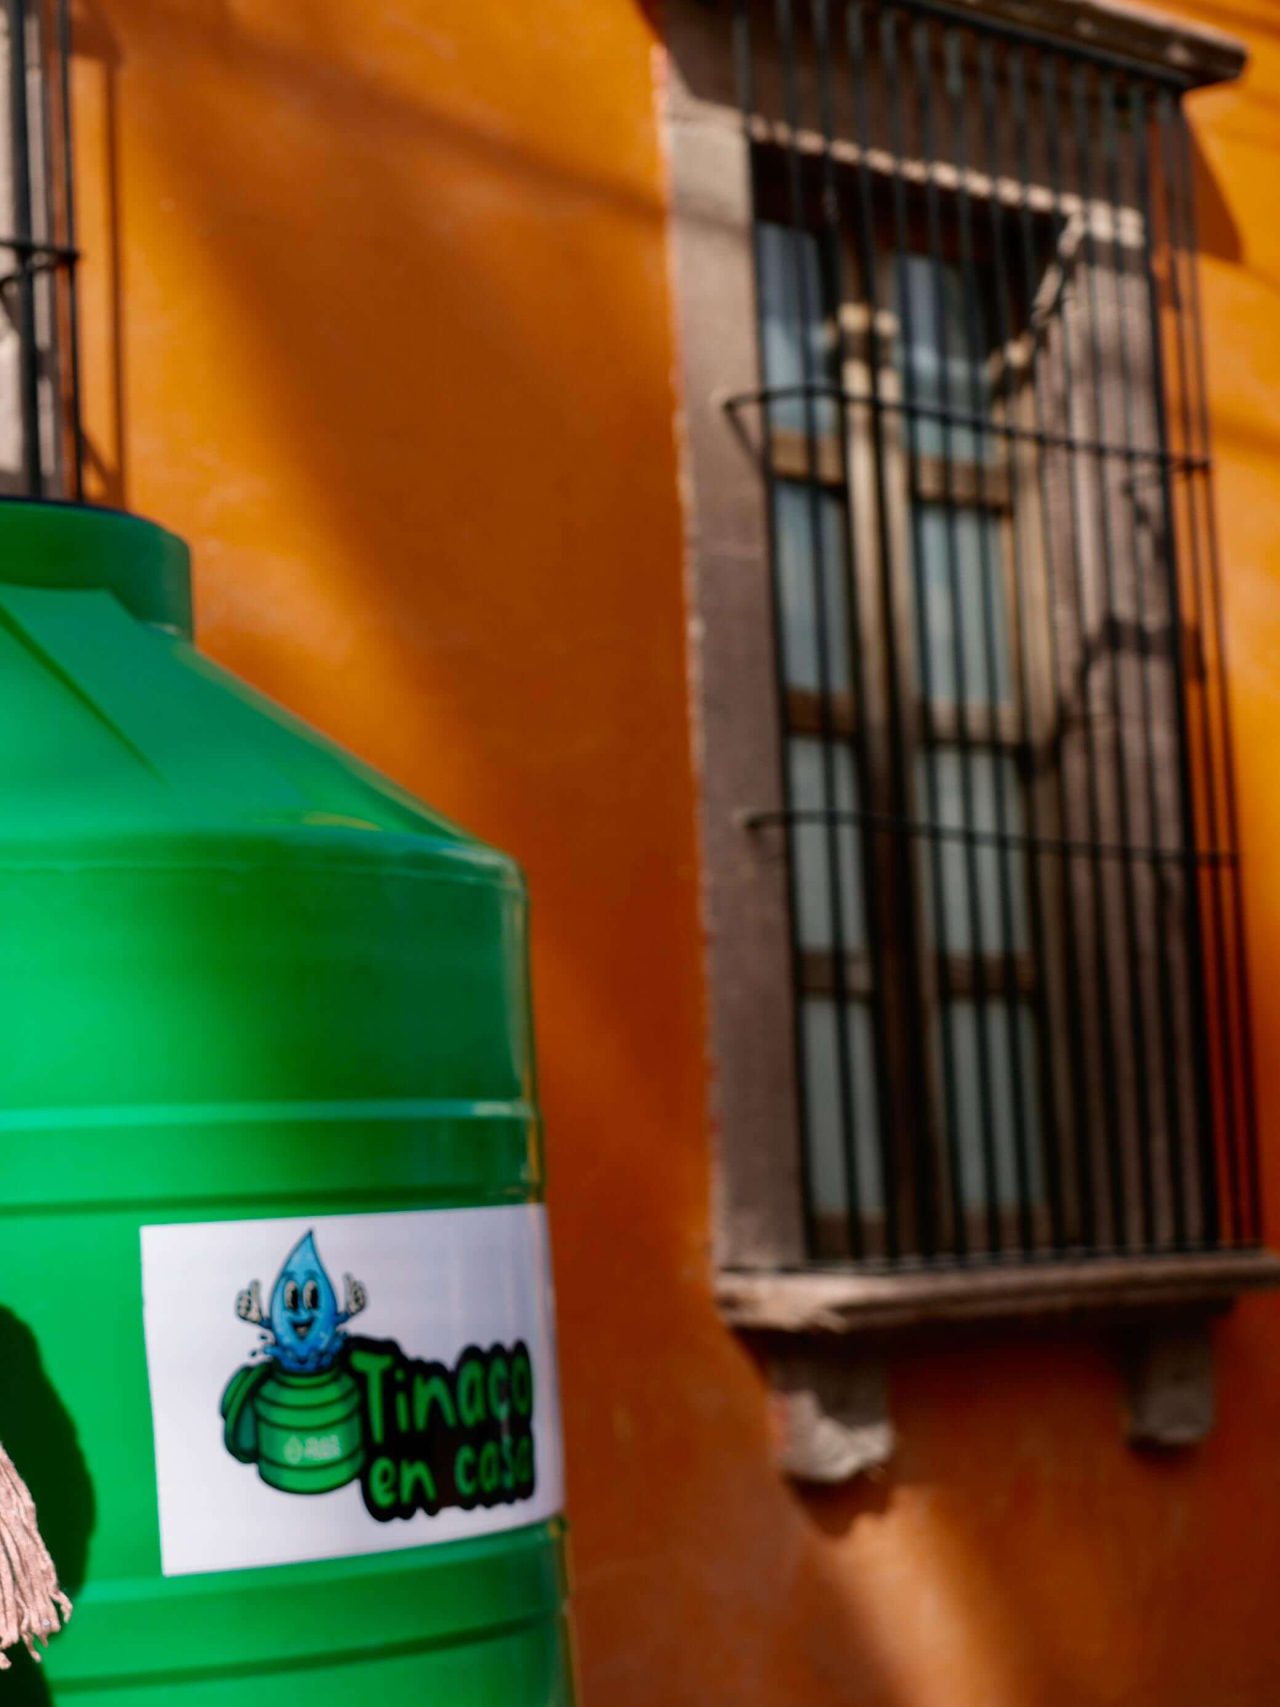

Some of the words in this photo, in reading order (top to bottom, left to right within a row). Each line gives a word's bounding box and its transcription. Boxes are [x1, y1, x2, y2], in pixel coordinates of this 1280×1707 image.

[351, 1350, 531, 1443] Tinaco
[369, 1457, 438, 1507] en
[455, 1438, 532, 1496] casa
